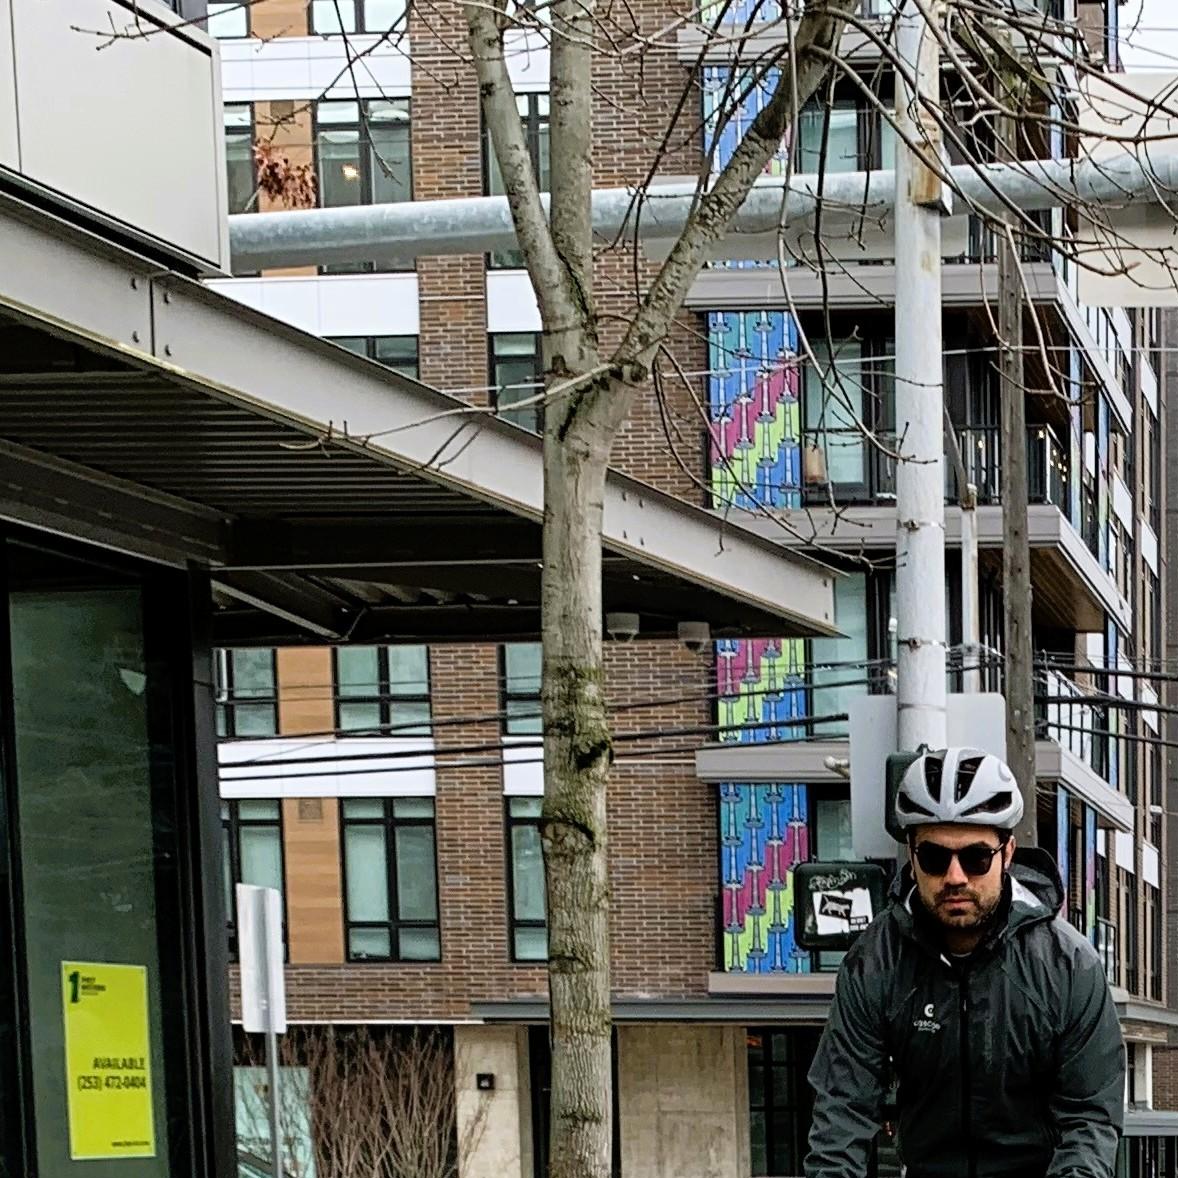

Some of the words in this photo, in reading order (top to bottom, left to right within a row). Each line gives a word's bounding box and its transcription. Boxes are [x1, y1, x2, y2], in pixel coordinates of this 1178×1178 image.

[93, 1057, 145, 1070] AVAILABLE
[77, 1075, 102, 1091] (253)
[105, 1075, 146, 1089] 472-0404
